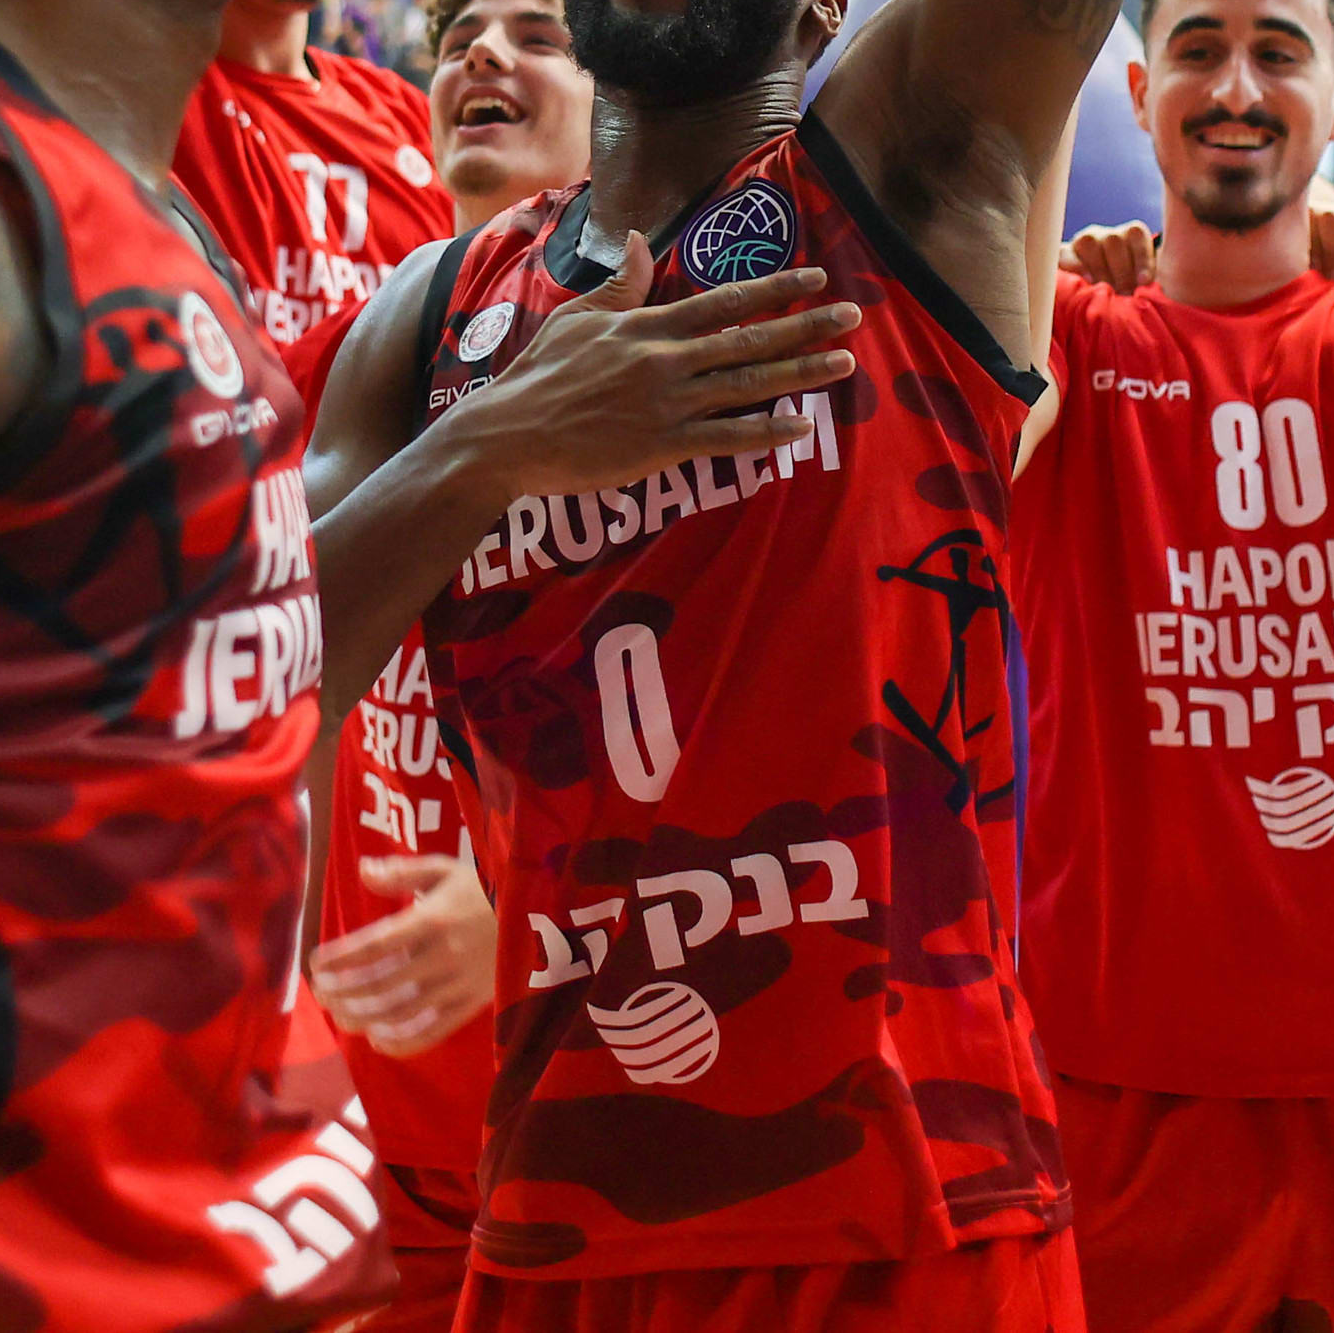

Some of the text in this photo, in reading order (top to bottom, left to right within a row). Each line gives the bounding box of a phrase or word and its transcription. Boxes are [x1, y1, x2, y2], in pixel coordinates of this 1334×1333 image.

[1210, 397, 1328, 531] 80
[594, 623, 681, 802] 0
[1145, 687, 1275, 749] יהב
[636, 839, 869, 970] בנק
